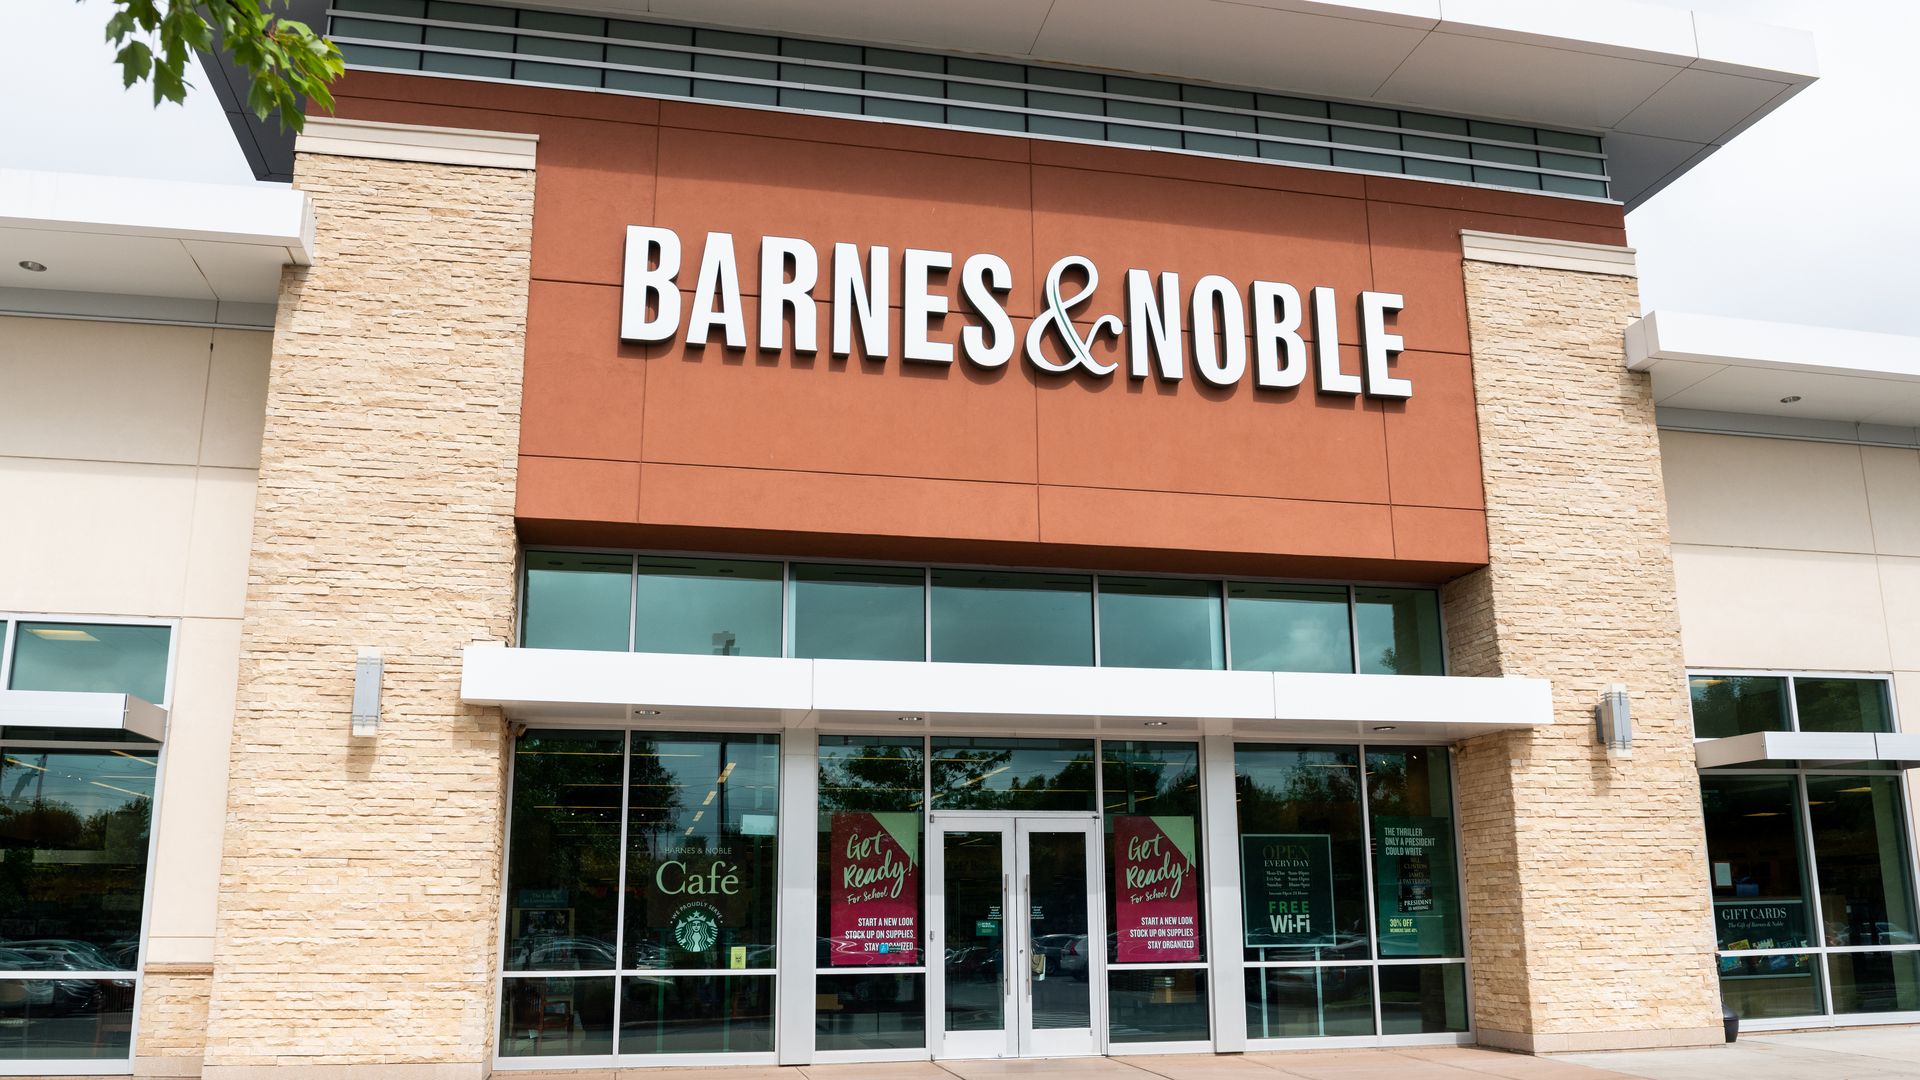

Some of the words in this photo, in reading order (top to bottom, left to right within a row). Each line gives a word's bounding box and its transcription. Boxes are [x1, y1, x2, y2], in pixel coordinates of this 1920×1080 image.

[621, 224, 1015, 369] BARNES
[1025, 256, 1123, 377] &
[1126, 268, 1412, 401] NOBLE
[1384, 827, 1395, 836] THE
[1396, 827, 1423, 836] THRILLER
[846, 831, 886, 860] Get
[1128, 833, 1164, 862] Get
[1385, 837, 1399, 846] ONLY
[1400, 838, 1404, 846] A
[1405, 837, 1435, 847] PRESIDENT
[697, 847, 703, 855] &
[705, 847, 732, 855] NOBLE
[1263, 844, 1310, 859] OPEN
[1385, 847, 1404, 856] COULD
[1405, 847, 1423, 856] WRITE
[655, 860, 739, 895] Café
[843, 849, 914, 899] Ready!
[1126, 851, 1192, 899] Ready!
[847, 893, 861, 905] For
[863, 886, 888, 902] School
[1130, 893, 1144, 905] For
[1146, 886, 1168, 902] School
[680, 901, 708, 911] PROUDLY
[708, 904, 723, 919] SERVE
[1268, 901, 1310, 914] FREE
[1722, 908, 1748, 920] GIFT
[1750, 907, 1787, 919] CARDS
[858, 918, 877, 927] START
[878, 918, 883, 926] A
[884, 917, 897, 926] NEW
[898, 917, 914, 926] LOOK
[1141, 917, 1159, 926] START
[1159, 917, 1164, 925] A
[1165, 917, 1177, 925] NEW
[1178, 916, 1193, 925] LOOK
[1269, 914, 1311, 934] Wi-Fi
[1402, 918, 1413, 927] OFF
[845, 931, 866, 940] STOCK
[867, 931, 875, 939] UP
[876, 930, 885, 939] ON
[886, 929, 914, 939] SUPPLIES
[1130, 929, 1148, 938] STOCK
[1149, 929, 1157, 938] UP
[1158, 929, 1166, 937] ON
[1167, 928, 1194, 937] SUPPLIES
[864, 942, 879, 952] STAY
[1147, 941, 1162, 950] STAY
[1162, 940, 1195, 949] ORGANIZED
